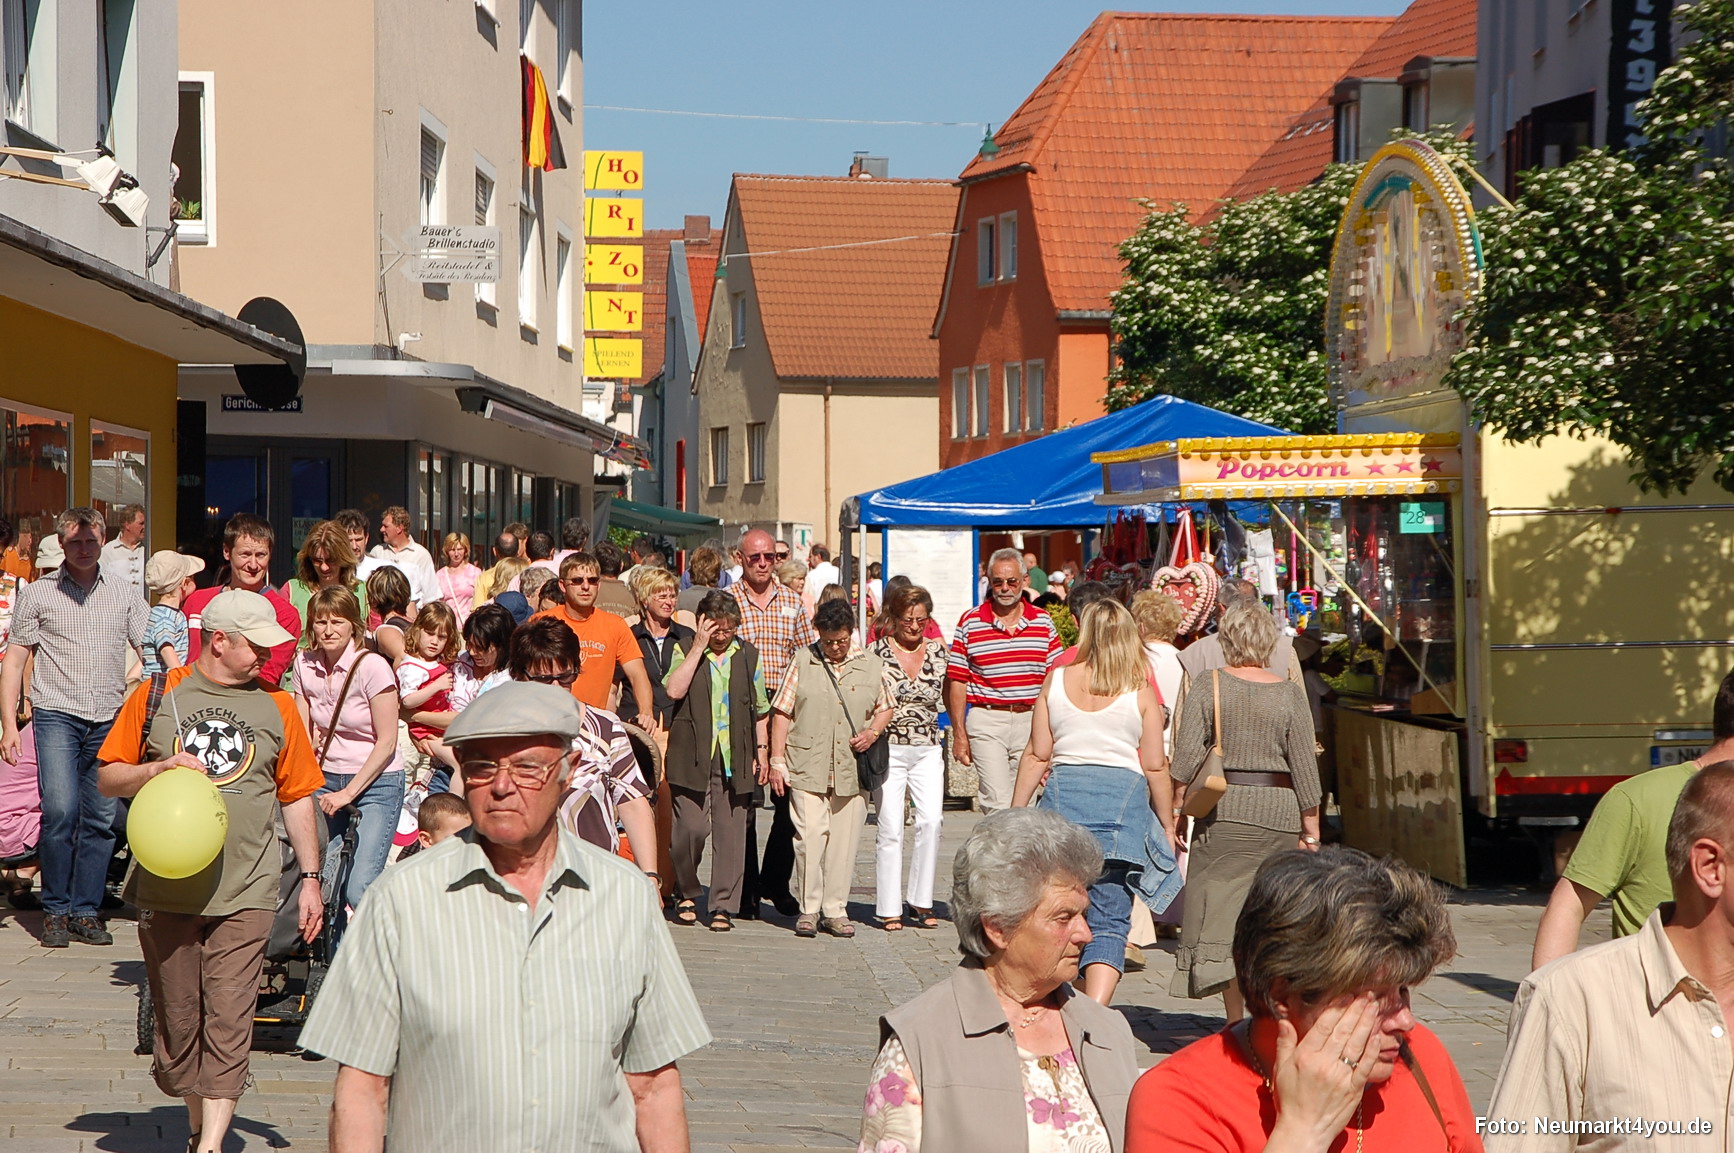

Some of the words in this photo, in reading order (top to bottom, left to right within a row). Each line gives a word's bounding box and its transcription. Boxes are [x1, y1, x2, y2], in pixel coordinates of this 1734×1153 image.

[420, 226, 461, 237] Bauer's
[428, 238, 496, 249] Brillenstudio
[484, 261, 493, 270] &
[1216, 457, 1351, 481] Popcorn
[1405, 510, 1425, 525] 28
